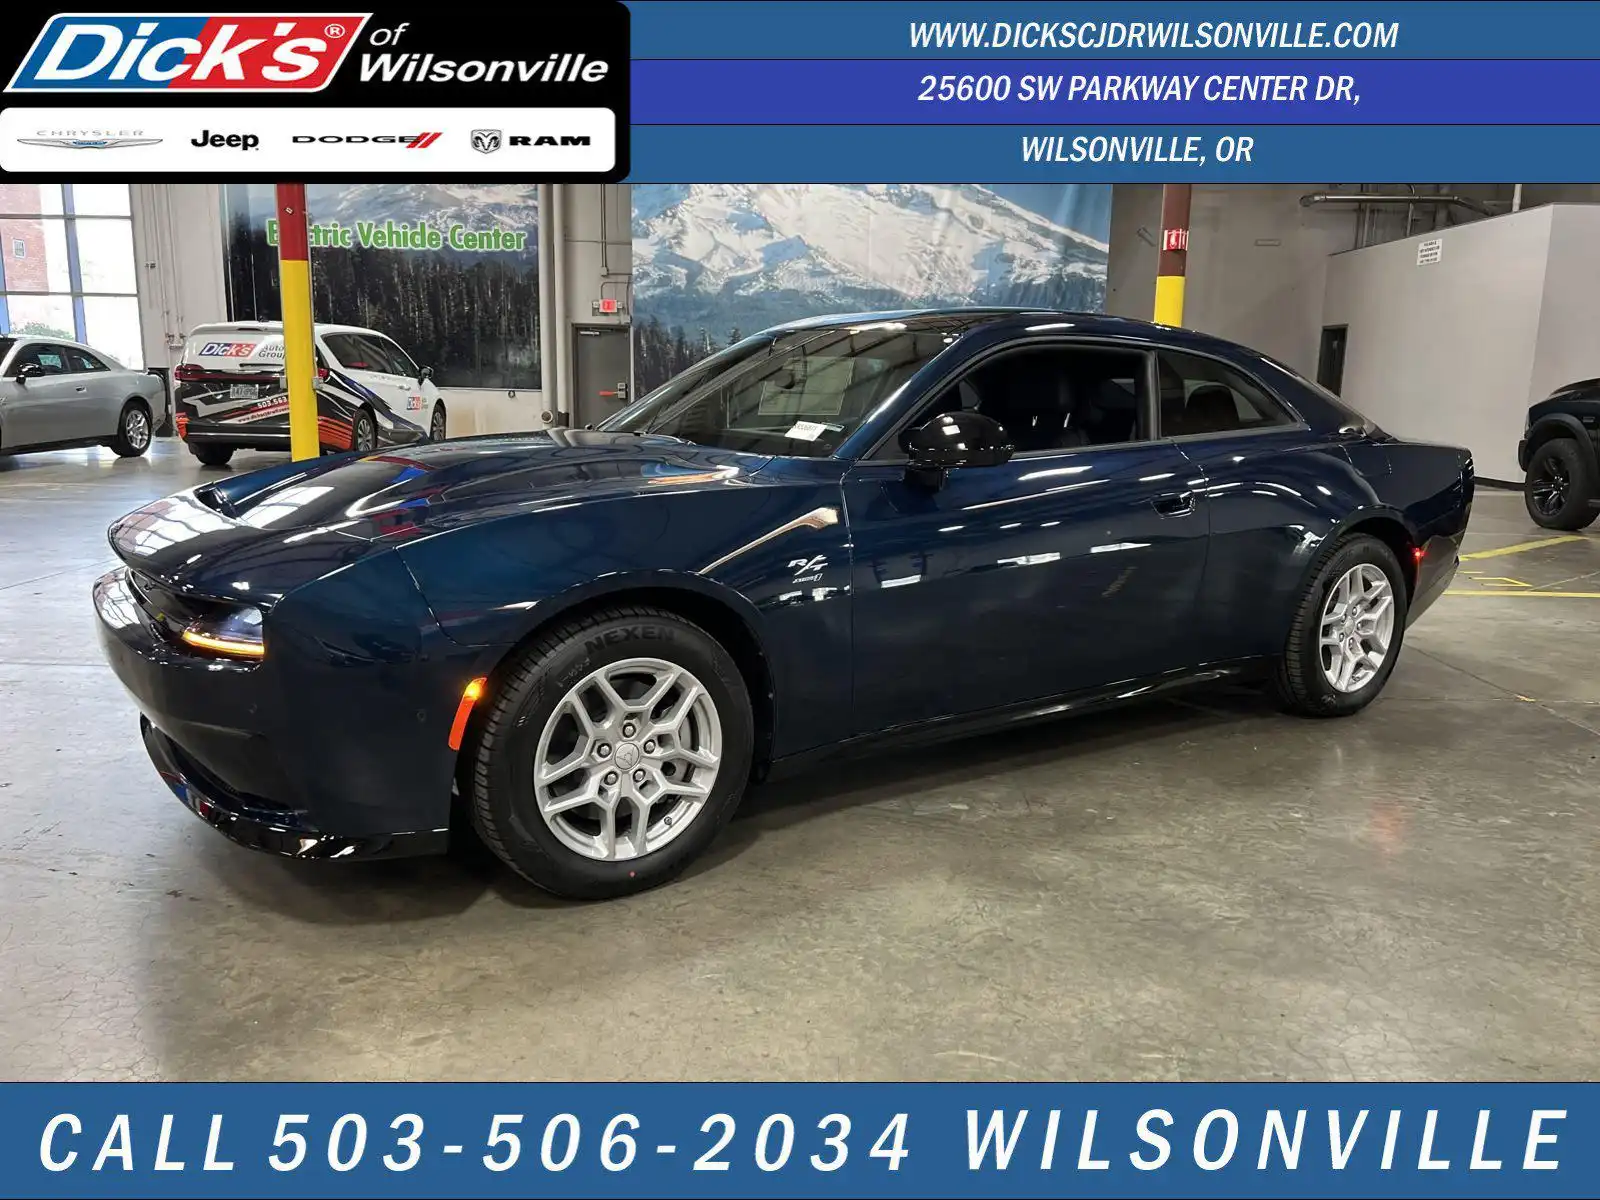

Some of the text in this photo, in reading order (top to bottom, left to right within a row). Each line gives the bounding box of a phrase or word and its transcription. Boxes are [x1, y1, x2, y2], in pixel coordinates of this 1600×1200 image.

[357, 221, 441, 250] Vehicle
[449, 224, 527, 252] Center
[585, 624, 676, 654] NEXEN
